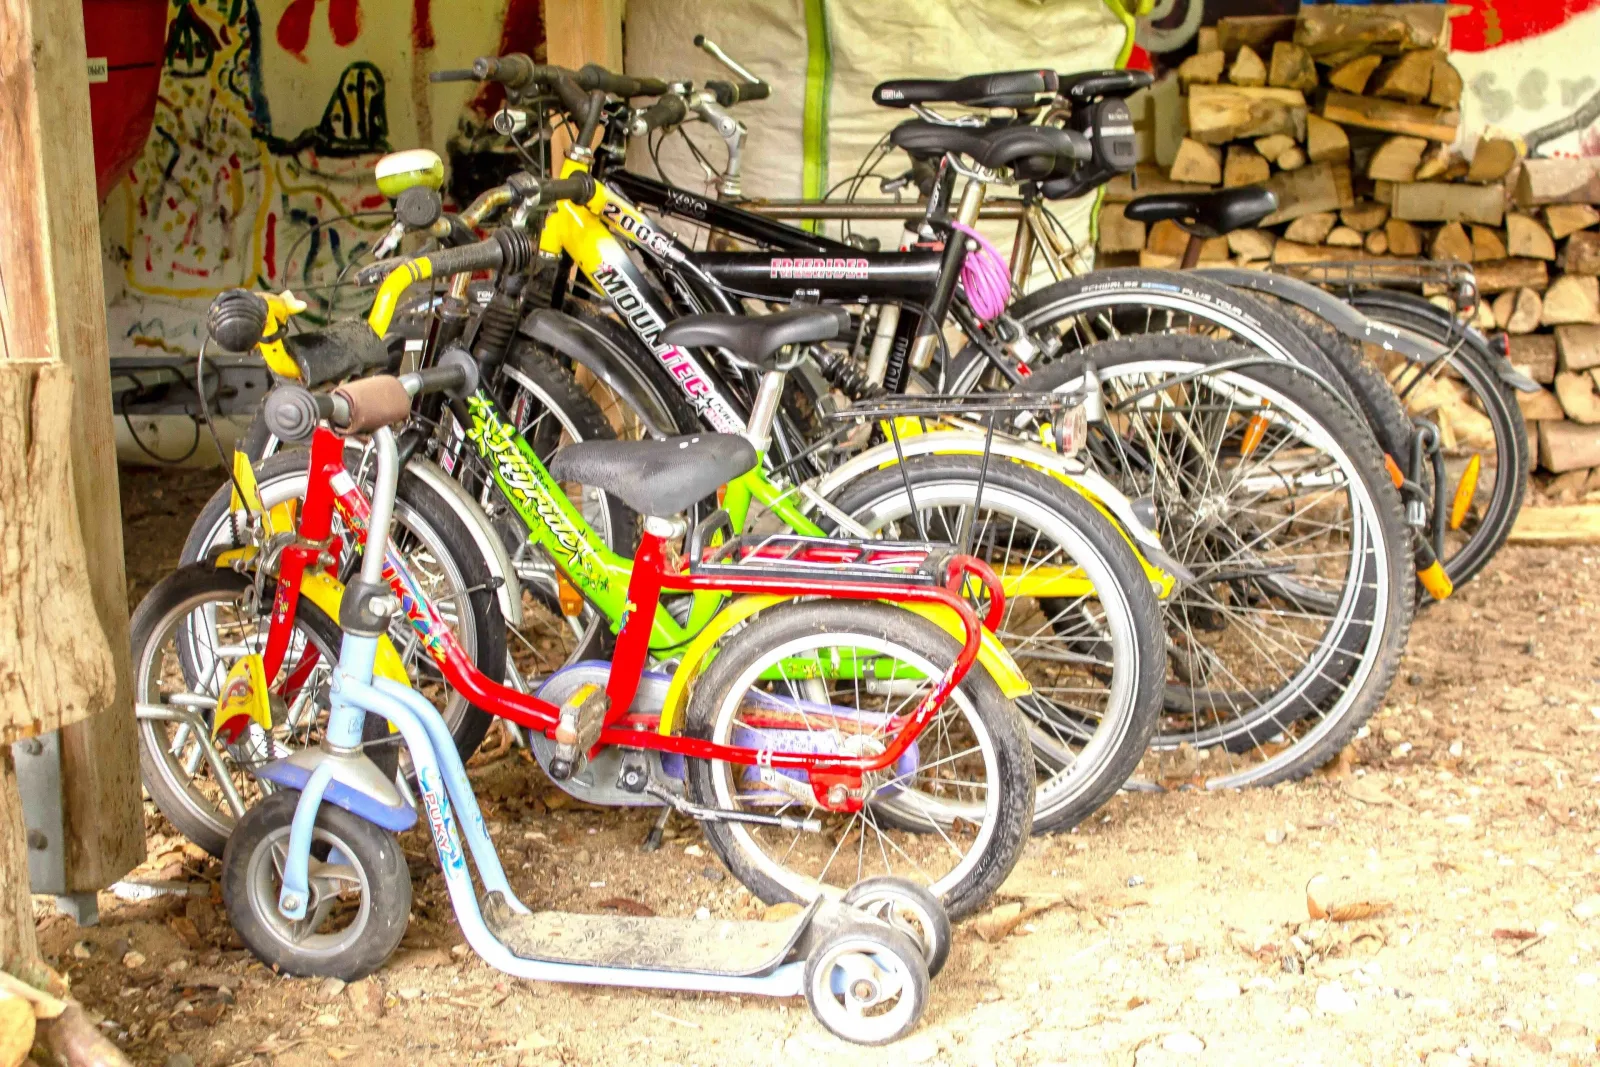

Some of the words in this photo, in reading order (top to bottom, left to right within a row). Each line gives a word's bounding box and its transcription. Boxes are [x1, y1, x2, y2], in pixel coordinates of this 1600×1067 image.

[770, 258, 869, 279] FREERIDER
[1181, 287, 1212, 301] PLUS
[382, 553, 428, 622] UKY
[425, 789, 452, 853] PUKY
